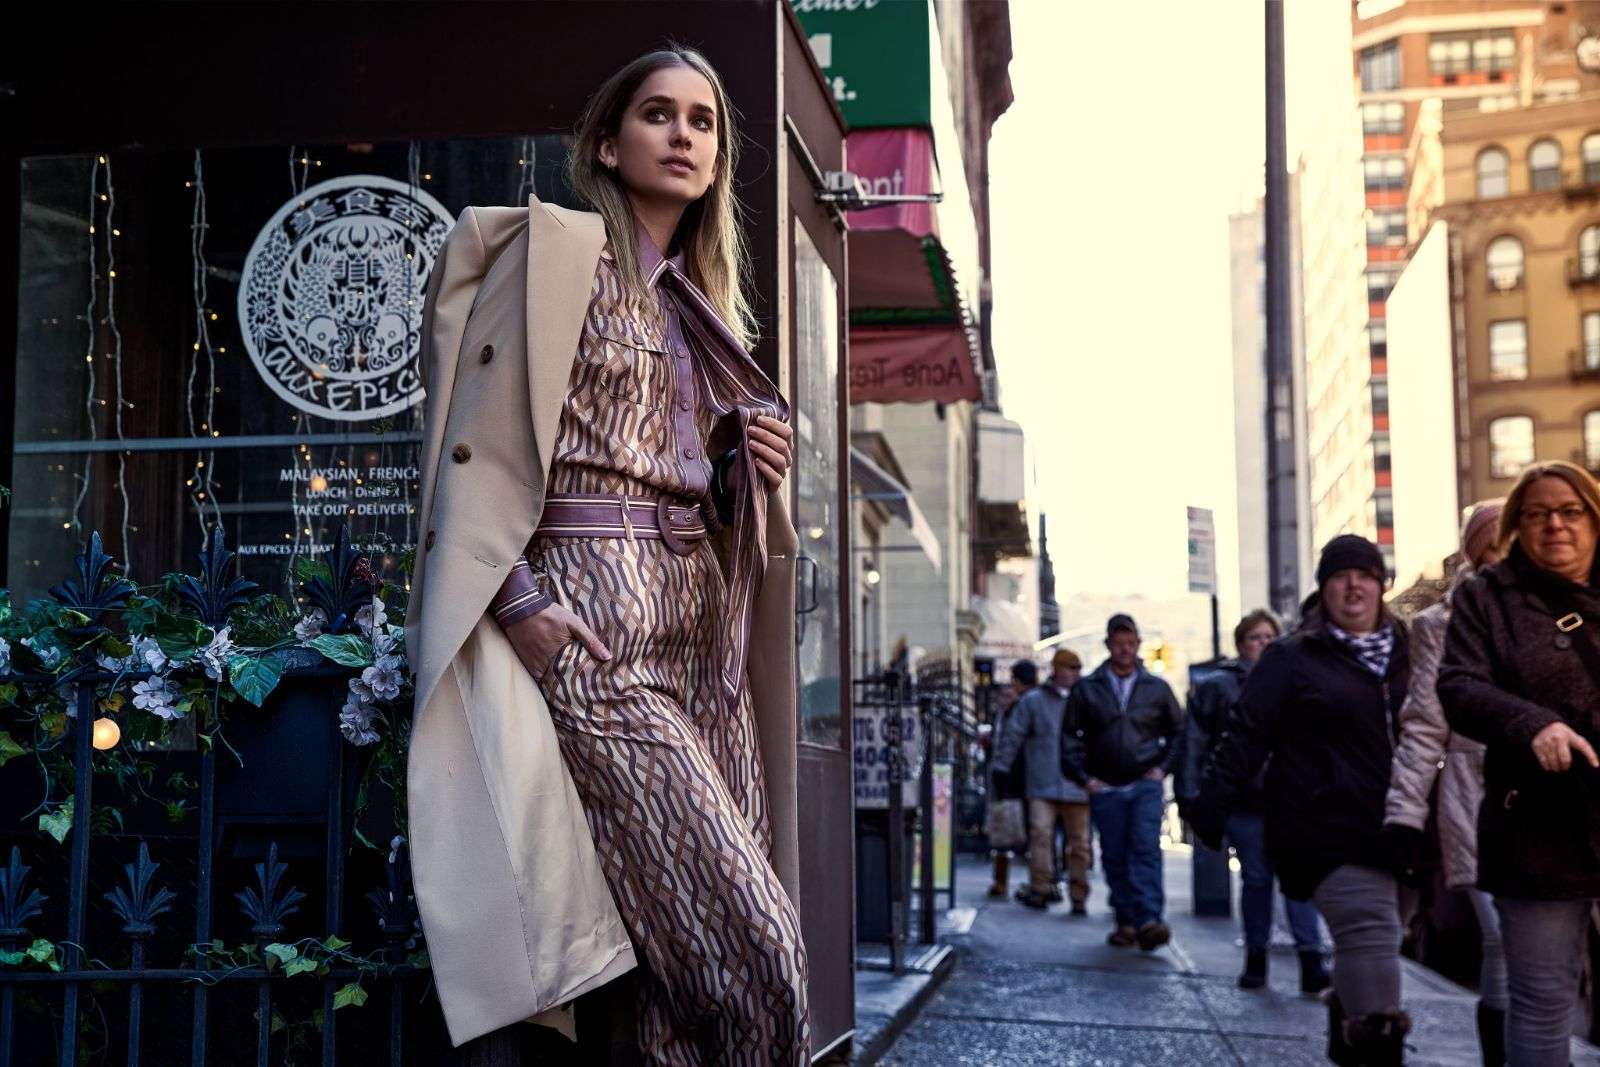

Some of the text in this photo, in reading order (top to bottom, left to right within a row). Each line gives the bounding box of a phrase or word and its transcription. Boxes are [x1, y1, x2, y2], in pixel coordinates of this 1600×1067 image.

[280, 467, 420, 481] MALAYSIAN FRENCH
[306, 487, 346, 498] LUNCH
[293, 503, 411, 515] TAKE OUT DELIVERY
